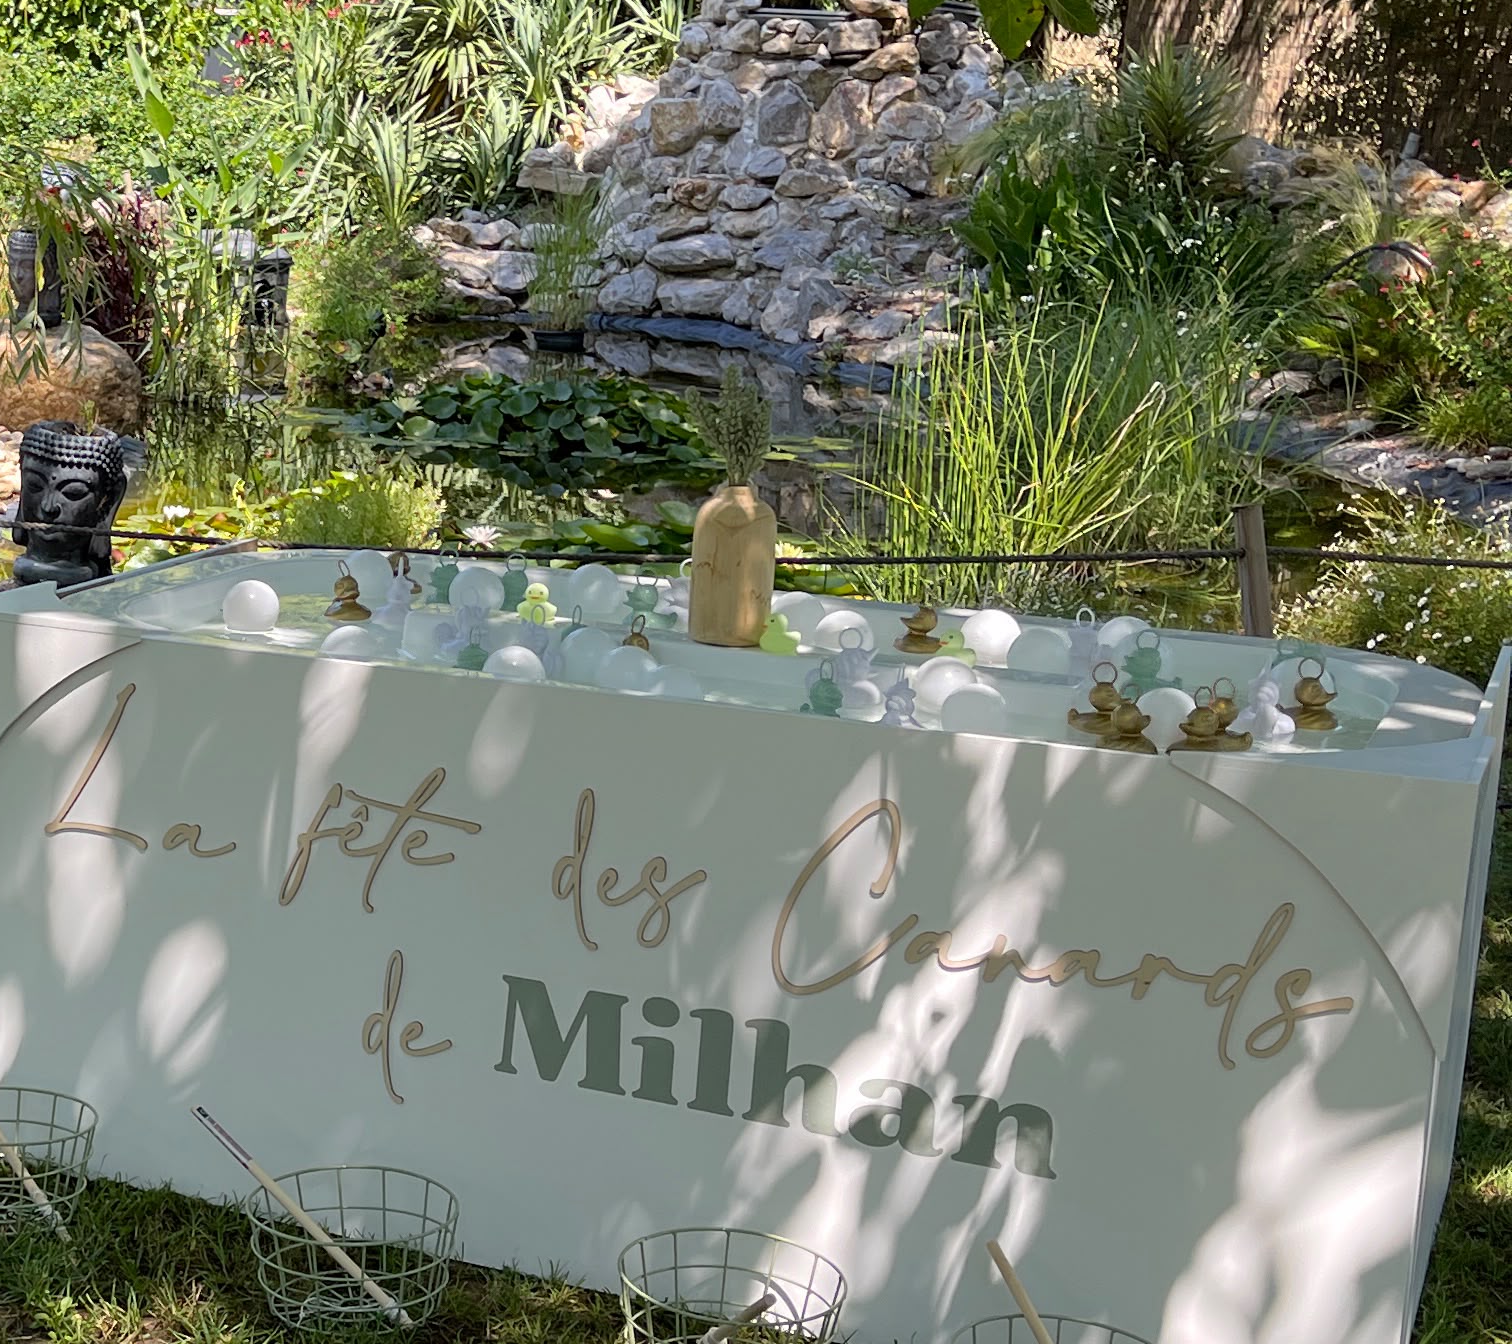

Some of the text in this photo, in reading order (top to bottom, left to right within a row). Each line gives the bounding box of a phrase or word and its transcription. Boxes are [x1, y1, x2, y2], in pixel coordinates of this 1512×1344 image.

[44, 682, 1355, 1071] La fête des Canards
[361, 949, 1058, 1181] de Milhan
